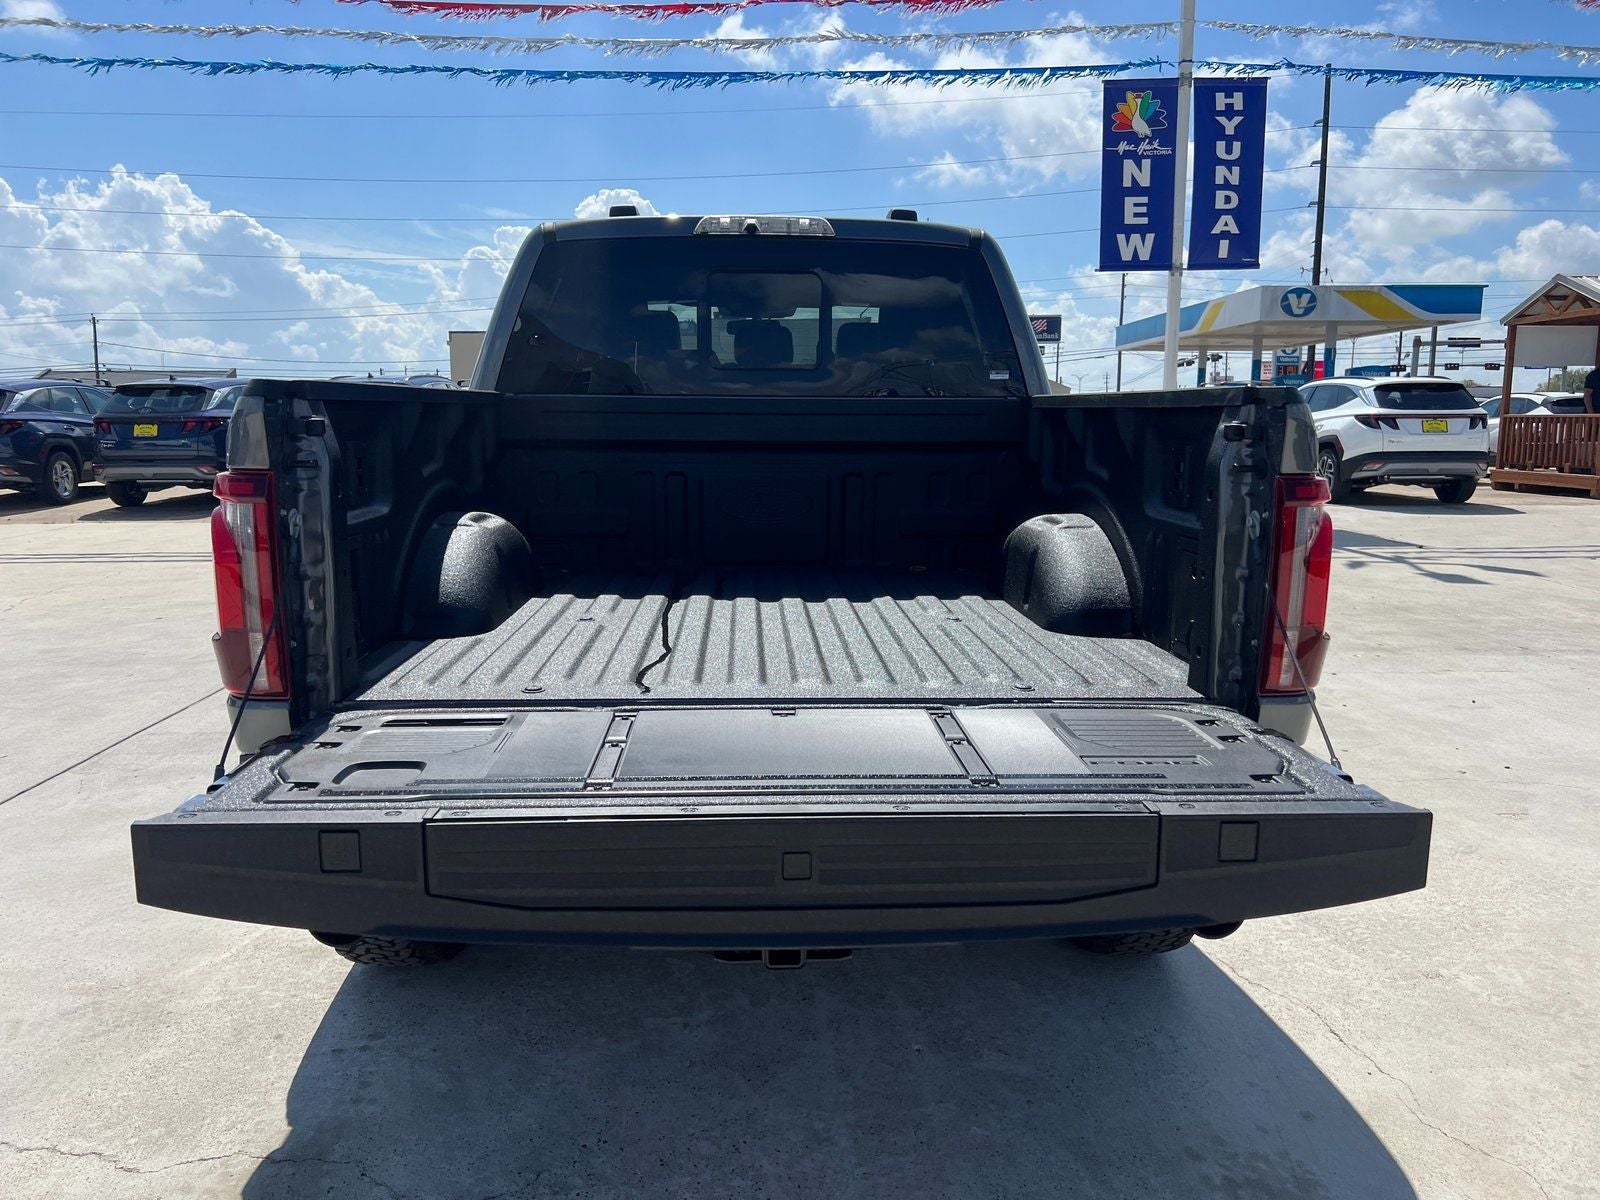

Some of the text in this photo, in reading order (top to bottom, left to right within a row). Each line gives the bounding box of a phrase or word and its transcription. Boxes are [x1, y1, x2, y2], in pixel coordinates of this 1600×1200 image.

[1108, 139, 1168, 155] Mac Haik
[1210, 92, 1244, 259] HYUNDAI
[1116, 158, 1155, 261] NEW
